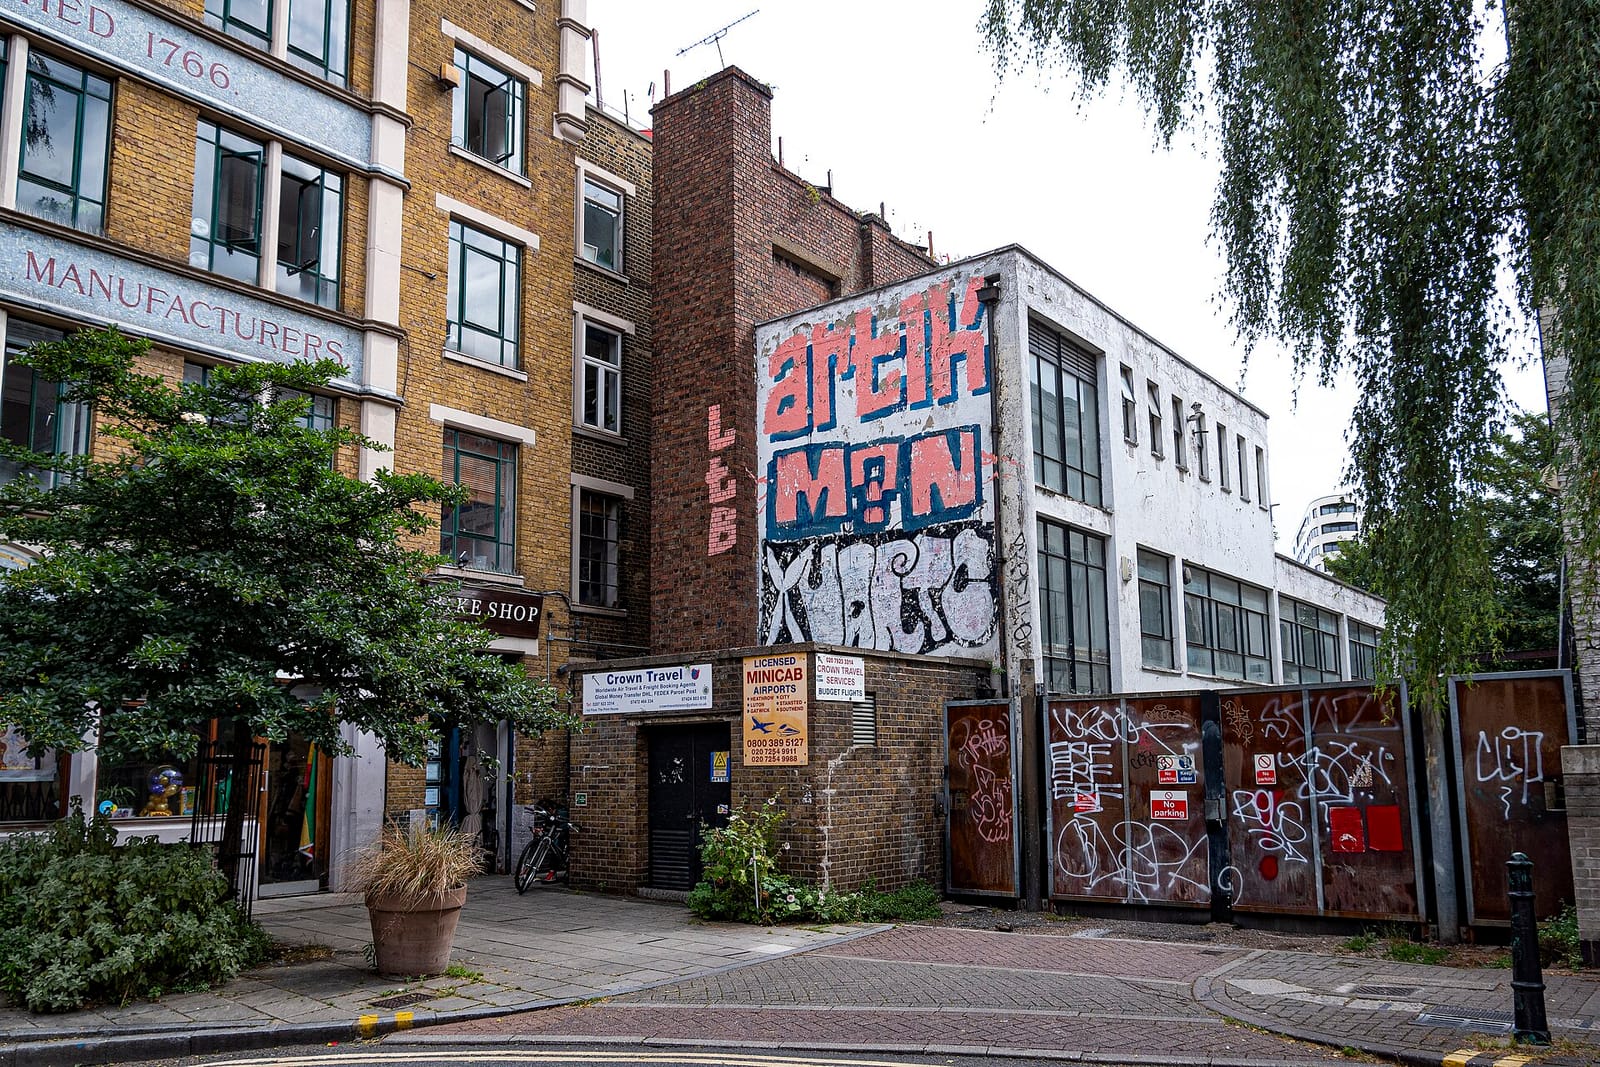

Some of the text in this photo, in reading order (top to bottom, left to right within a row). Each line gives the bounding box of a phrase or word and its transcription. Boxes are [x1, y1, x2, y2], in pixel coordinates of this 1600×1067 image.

[488, 602, 538, 622] SHOP
[754, 656, 796, 668] LICENSED
[747, 667, 803, 684] MINICAB
[817, 665, 864, 676] CROWN TRAVEL
[606, 668, 682, 685] Crown Travel
[826, 676, 856, 686] SERVICES
[753, 684, 796, 695] AIRPORTS
[818, 688, 862, 696] BUDGET FLIGHTS
[768, 739, 784, 747] 389
[786, 738, 804, 746] 5127
[1154, 809, 1184, 818] parking
